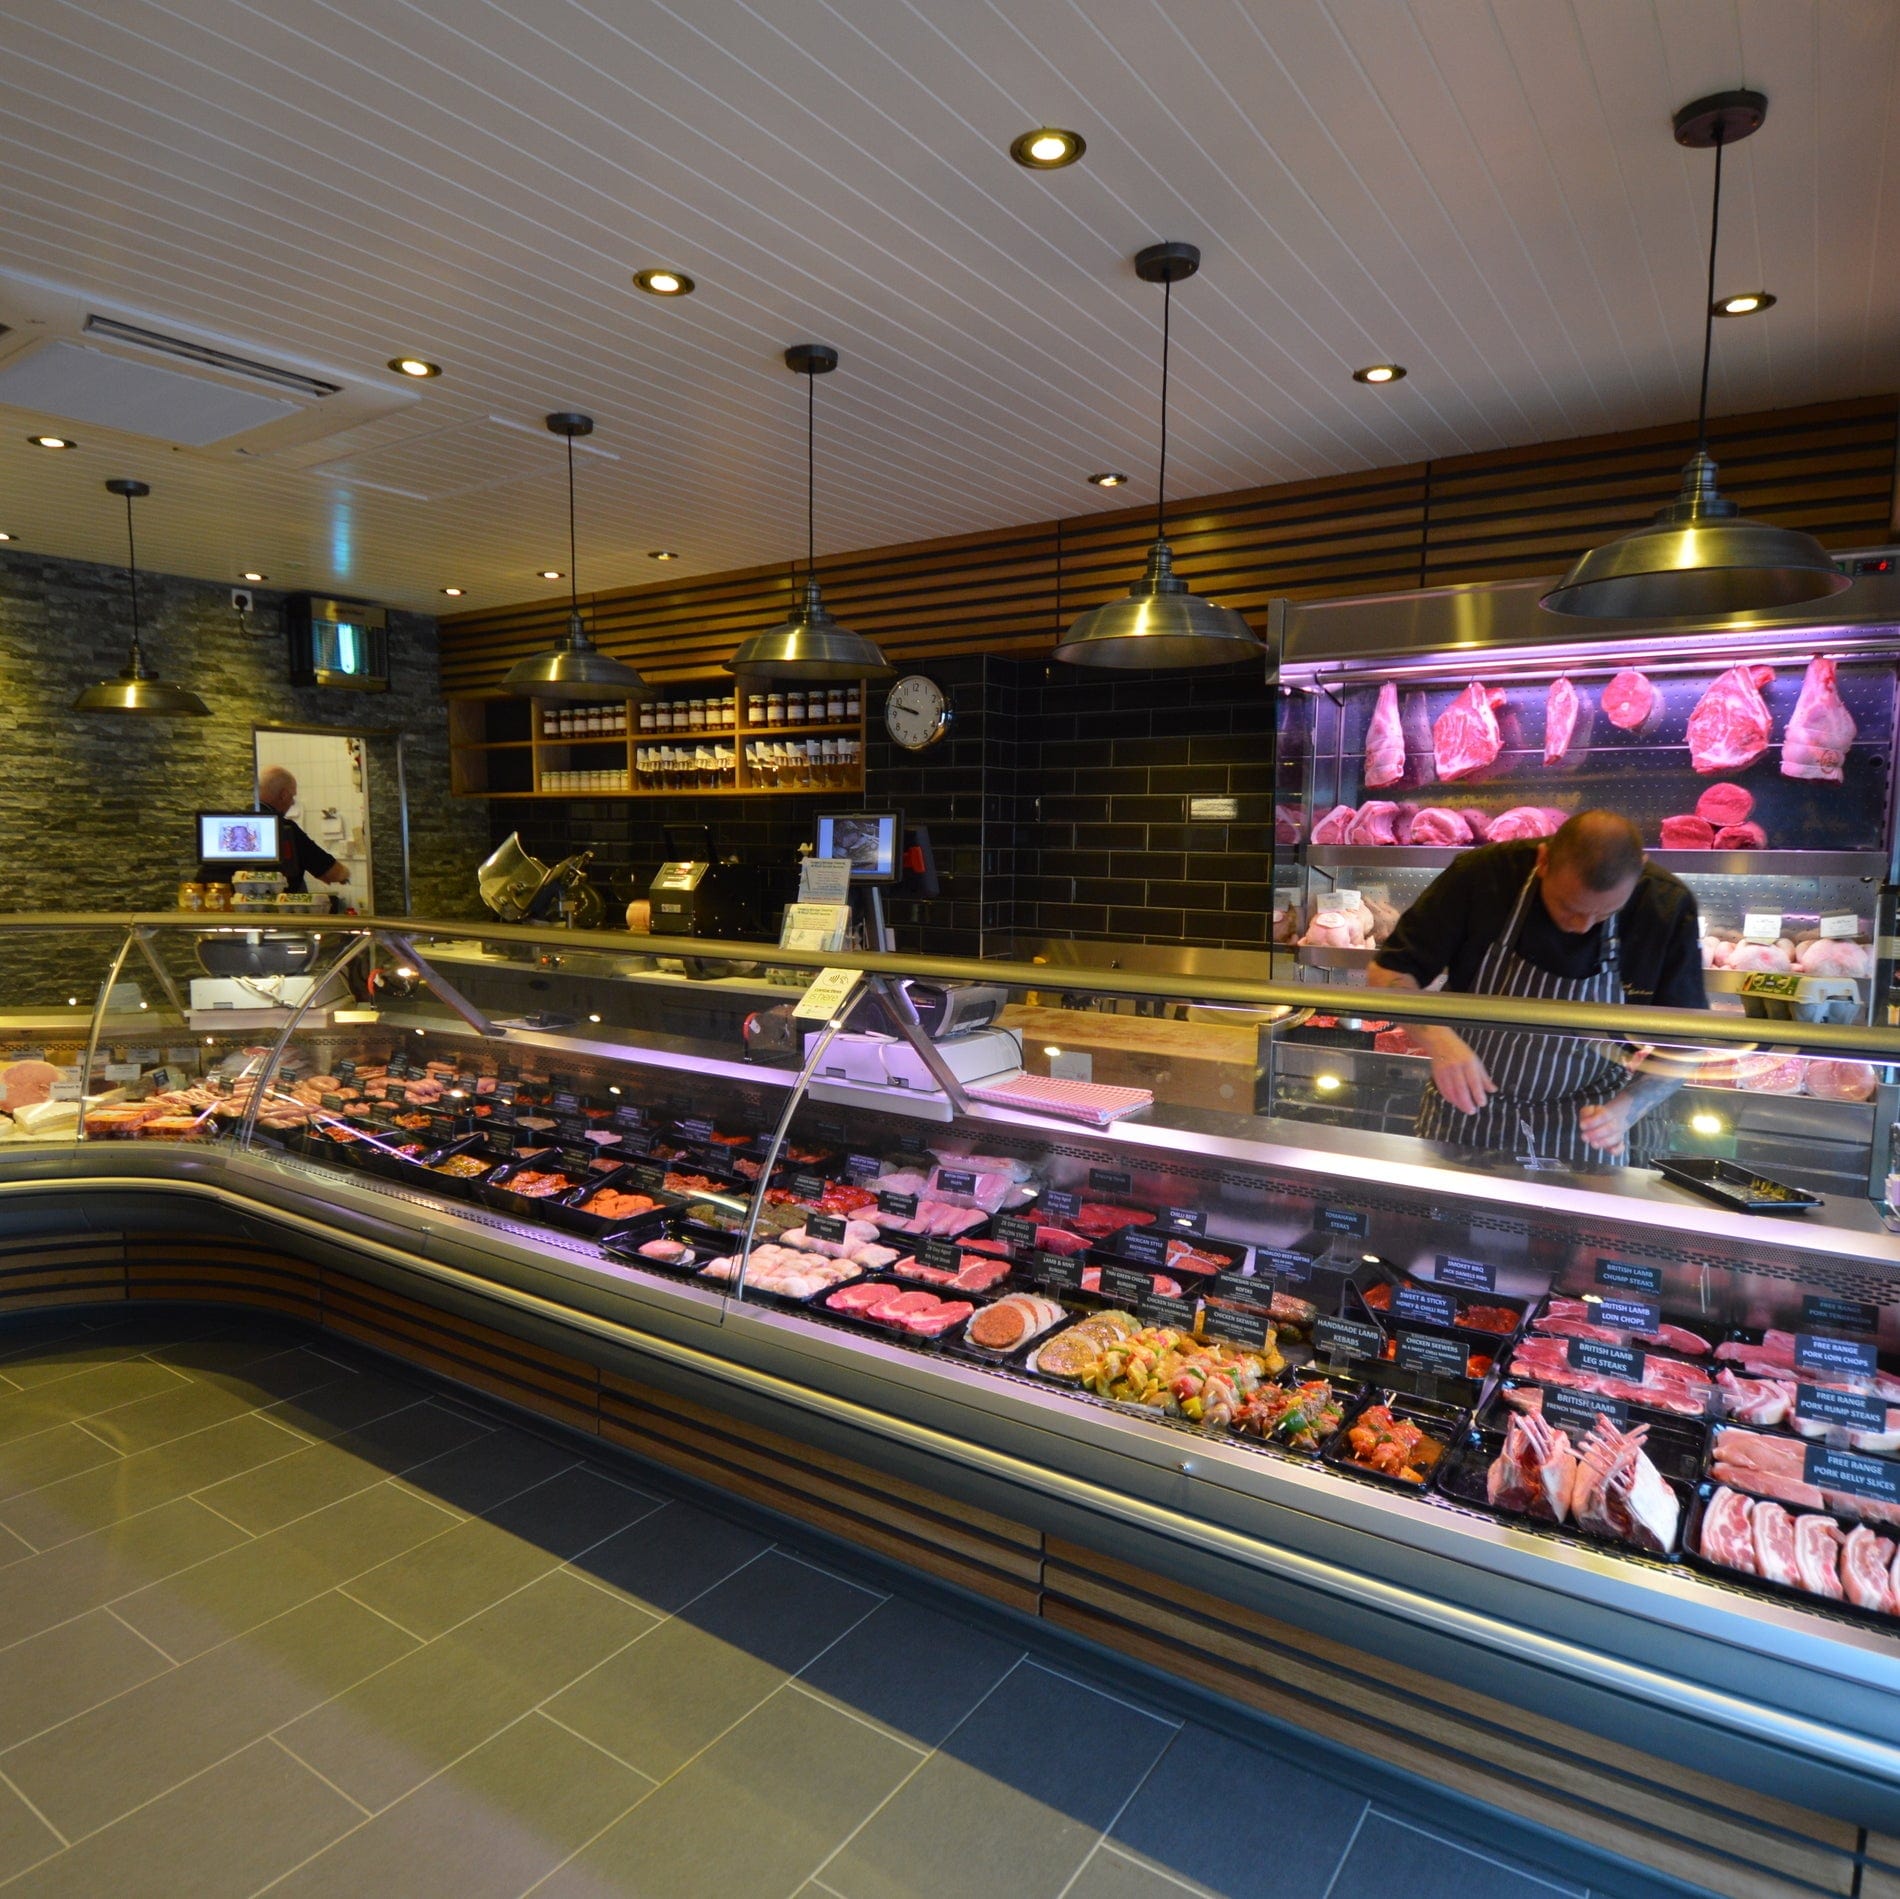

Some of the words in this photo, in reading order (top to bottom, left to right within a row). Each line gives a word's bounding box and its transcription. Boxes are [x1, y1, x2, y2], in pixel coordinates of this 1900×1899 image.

[1447, 1260, 1471, 1270] SMOKEY
[1607, 1264, 1632, 1274] BRITISH
[1633, 1269, 1653, 1278] LAMB
[1603, 1273, 1628, 1283] CHUMP
[1629, 1278, 1654, 1288] STEAKS
[1400, 1292, 1419, 1300] SWEET
[1426, 1298, 1447, 1306] STICKY
[1600, 1302, 1628, 1312] BRITISH
[1629, 1305, 1650, 1316] LAMB
[1602, 1313, 1619, 1321] LOIN
[1620, 1316, 1645, 1326] CHOPS
[1318, 1319, 1357, 1335] HANDMADE
[1358, 1328, 1378, 1340] LAMB
[1334, 1334, 1359, 1346] KEBABS
[1406, 1337, 1430, 1347] CHICKEN
[1579, 1343, 1609, 1355] BRITISH
[1610, 1350, 1633, 1361] LAMB
[1813, 1341, 1830, 1350] FREE
[1832, 1344, 1858, 1355] RANGE
[1583, 1356, 1597, 1364] LEG
[1598, 1360, 1627, 1372] STEAKS
[1802, 1350, 1823, 1359] PORK
[1824, 1353, 1842, 1362] LOIN
[1843, 1357, 1868, 1367] CHOPS
[1557, 1393, 1590, 1407] BRITISH
[1591, 1402, 1616, 1413] LAMB
[1816, 1391, 1835, 1402] FREE
[1837, 1396, 1865, 1408] RANGE
[1546, 1402, 1568, 1413] FRENCH
[1801, 1400, 1823, 1411] PORK
[1824, 1405, 1850, 1415] RUMP
[1851, 1410, 1881, 1422] STEAKS
[1828, 1456, 1848, 1468] FREE
[1850, 1462, 1883, 1475] RANGE
[1813, 1465, 1839, 1478] PORK
[1840, 1472, 1865, 1484] BELLY
[1866, 1478, 1896, 1491] SLICES
